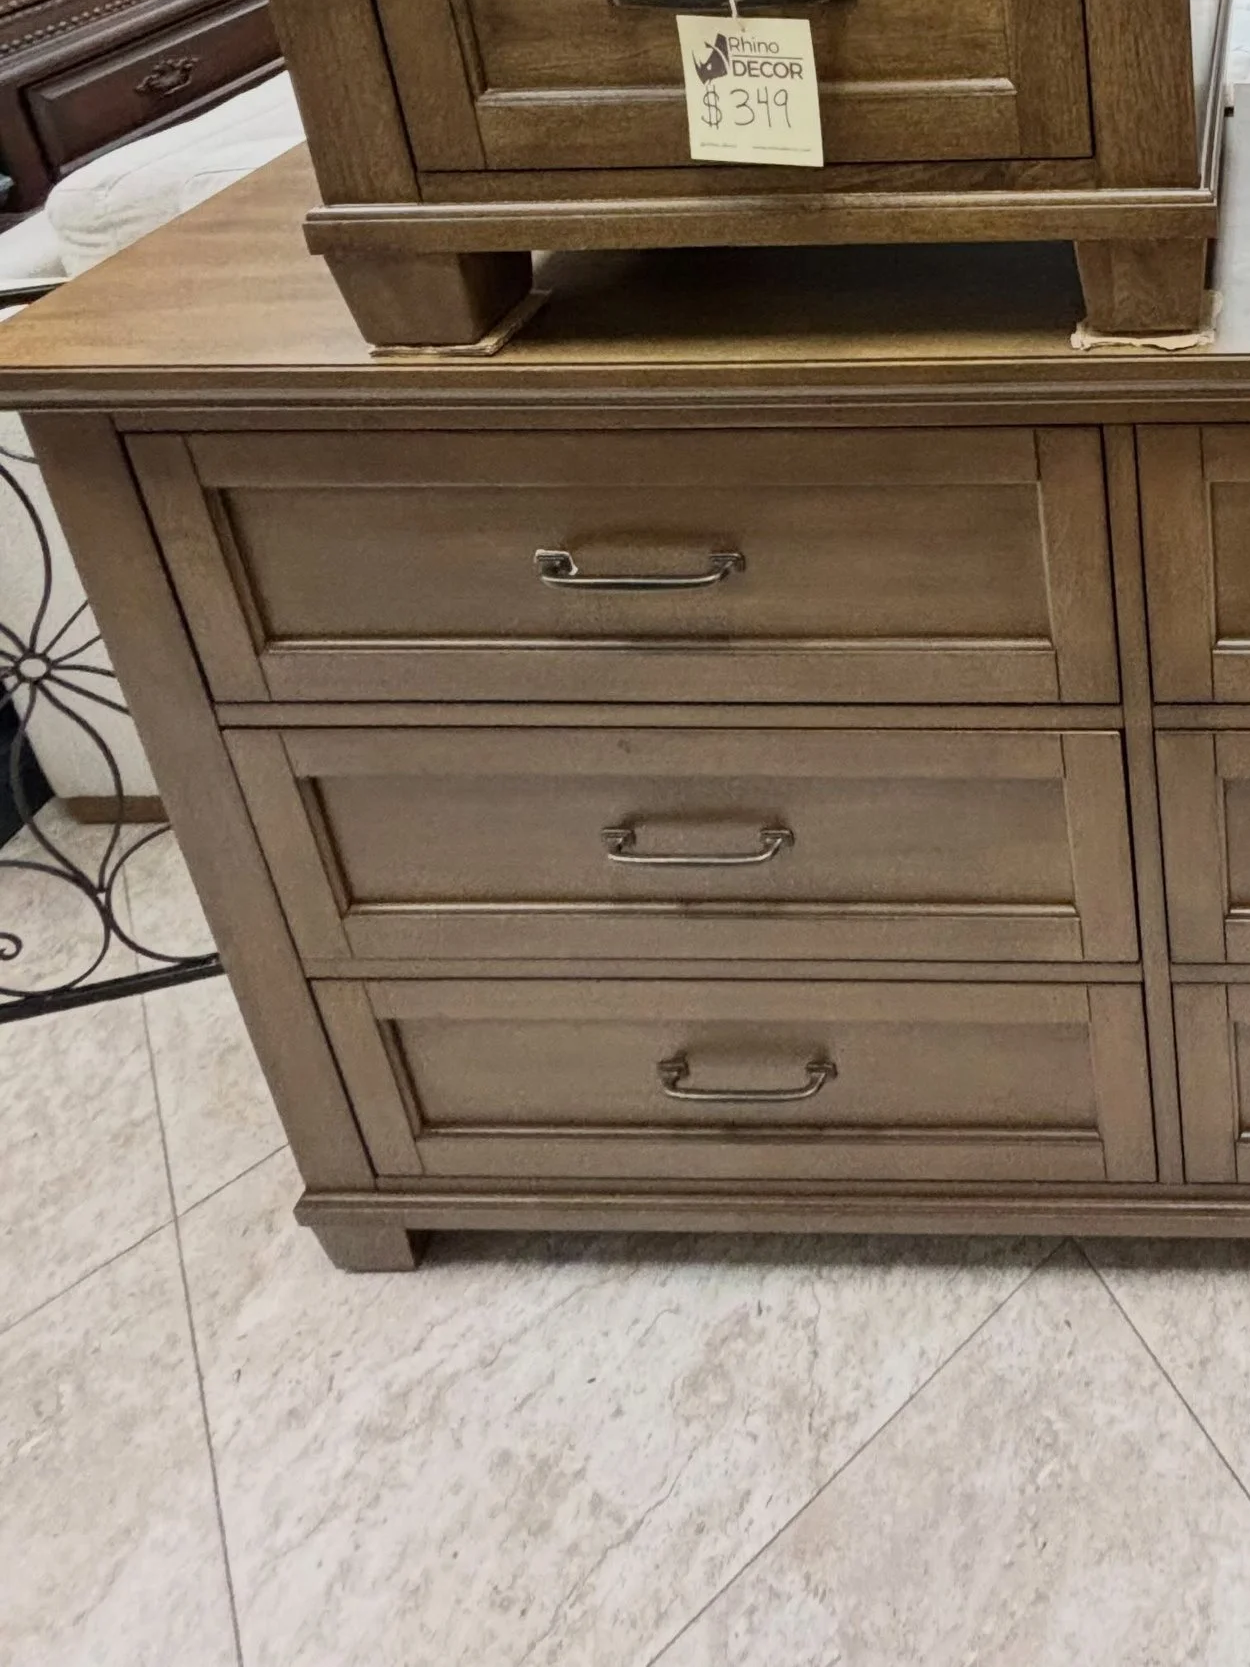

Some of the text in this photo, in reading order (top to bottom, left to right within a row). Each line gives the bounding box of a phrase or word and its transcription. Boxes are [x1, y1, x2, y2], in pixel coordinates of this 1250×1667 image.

[728, 36, 780, 54] Rhino
[732, 59, 803, 80] DECOR
[701, 84, 792, 130] $349
